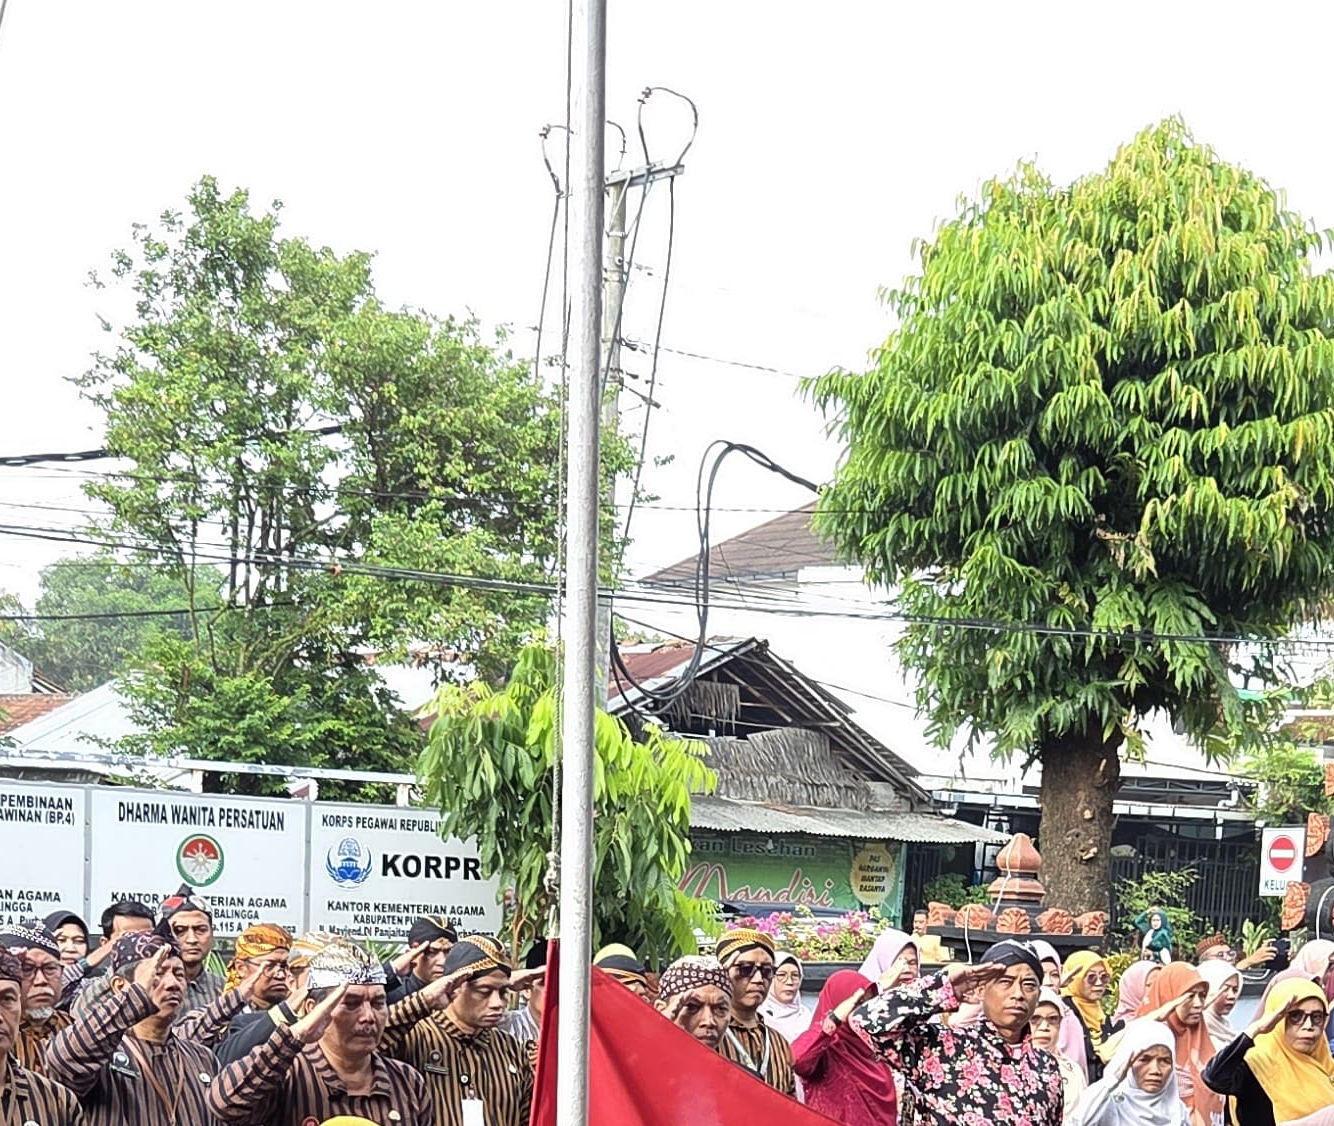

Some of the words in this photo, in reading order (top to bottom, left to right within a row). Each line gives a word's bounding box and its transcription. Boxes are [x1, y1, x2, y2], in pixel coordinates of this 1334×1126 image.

[0, 794, 73, 811] PEMBINAAN
[45, 812, 76, 826] (BP.4)
[118, 801, 168, 824] DHARMA
[171, 804, 215, 827] WANITA
[218, 807, 285, 831] PERSATUAN
[322, 814, 353, 828] KORPS
[356, 817, 397, 831] PEGAWAI
[400, 819, 442, 833] REPUBLI
[730, 836, 817, 857] Lesehan
[381, 853, 482, 881] KORPR
[676, 861, 835, 907] Mandiri
[1265, 879, 1286, 891] KELU
[17, 889, 61, 903] AGAMA
[111, 891, 159, 904] KANTOR
[248, 897, 287, 909] AGAMA
[213, 908, 259, 920] BALINGGA
[327, 900, 371, 913] KANTOR
[373, 902, 447, 915] KEMENTERIAN
[449, 905, 486, 917] AGAMA
[353, 913, 403, 925] KABUPATEN
